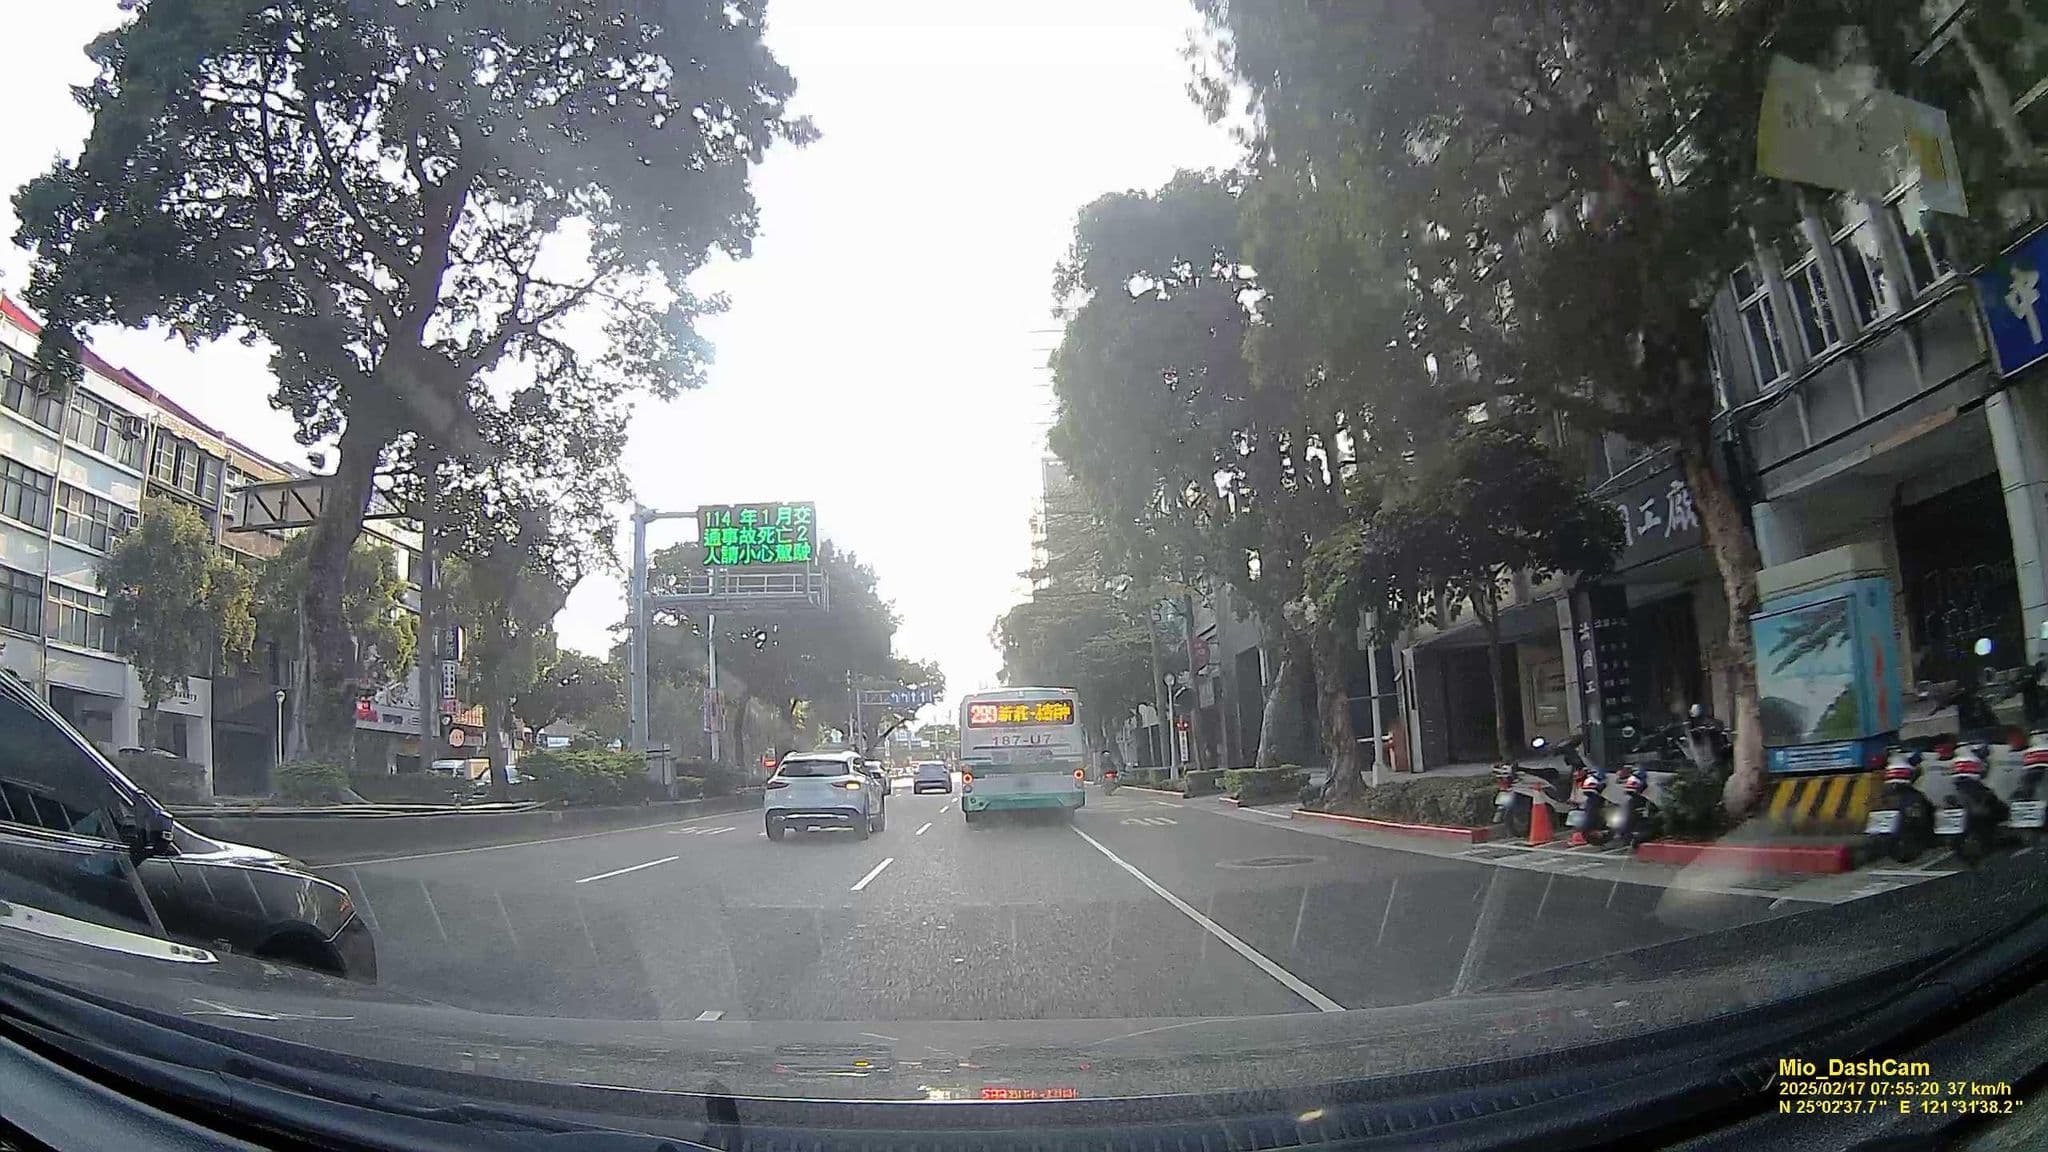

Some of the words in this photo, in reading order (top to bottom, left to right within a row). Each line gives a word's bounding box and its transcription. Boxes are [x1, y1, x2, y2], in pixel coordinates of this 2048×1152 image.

[704, 510, 731, 528] 114
[1617, 480, 1699, 547] 工廠
[703, 542, 812, 565] 人請小心駕駛
[992, 734, 1052, 746] 187-U7
